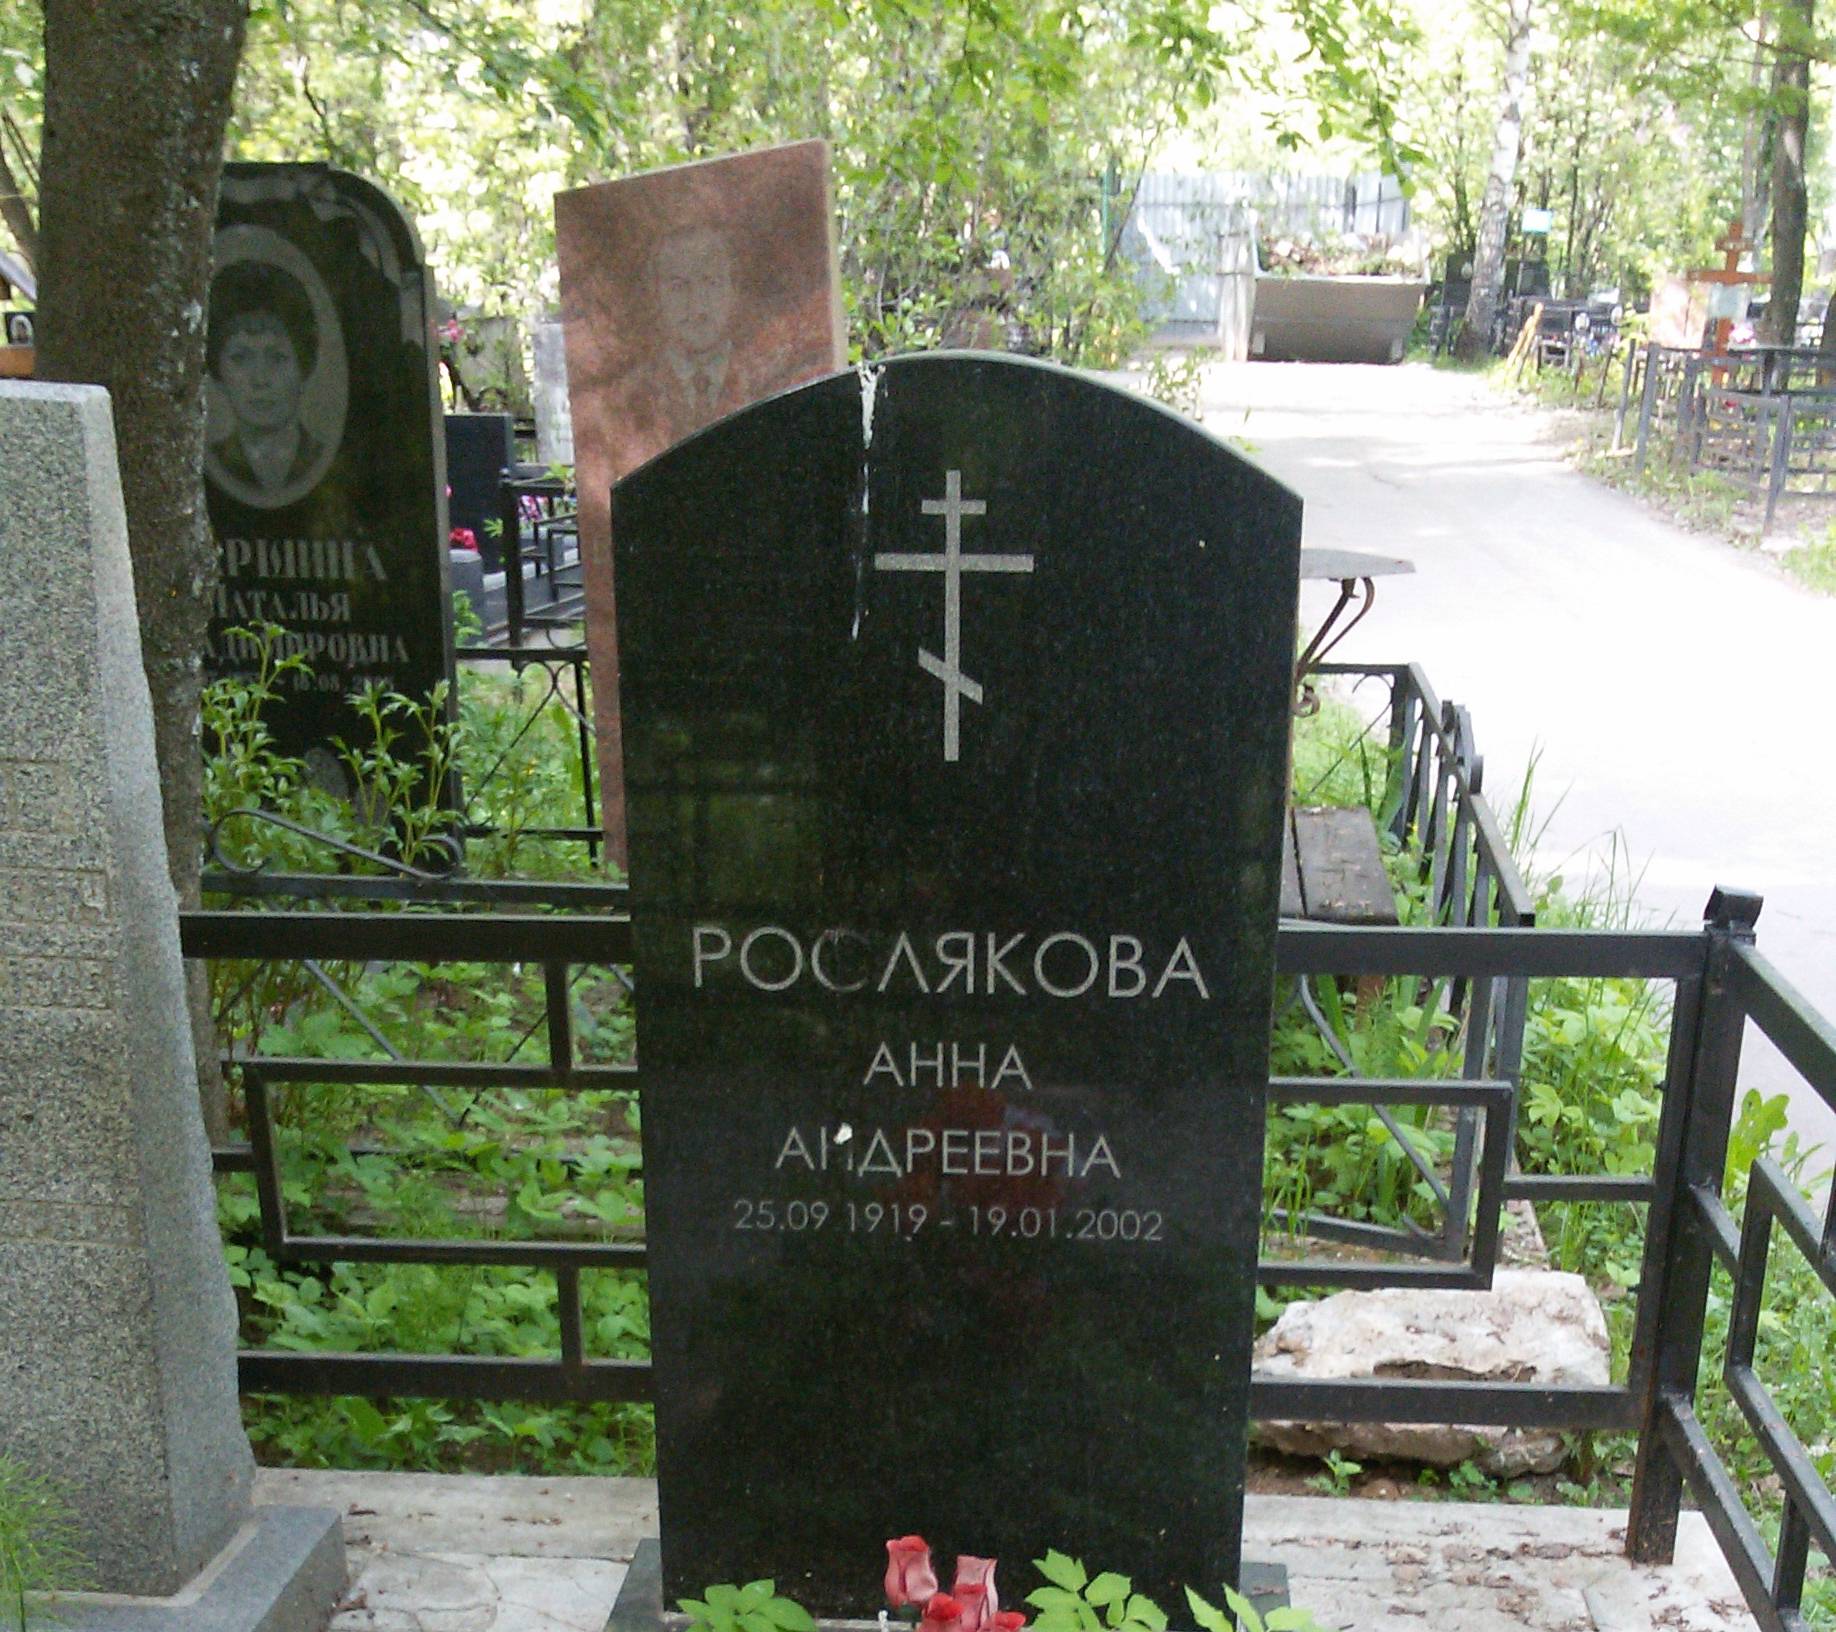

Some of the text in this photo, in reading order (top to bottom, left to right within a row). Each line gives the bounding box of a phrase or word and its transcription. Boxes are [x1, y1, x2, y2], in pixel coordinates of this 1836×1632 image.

[693, 926, 1210, 999] РОСЛЯКОВА
[863, 1041, 1033, 1090] АННА
[775, 1123, 1122, 1179] АНДРЕЕВНА
[848, 1202, 928, 1234] 1919
[970, 1205, 1163, 1241] 19.01.2002
